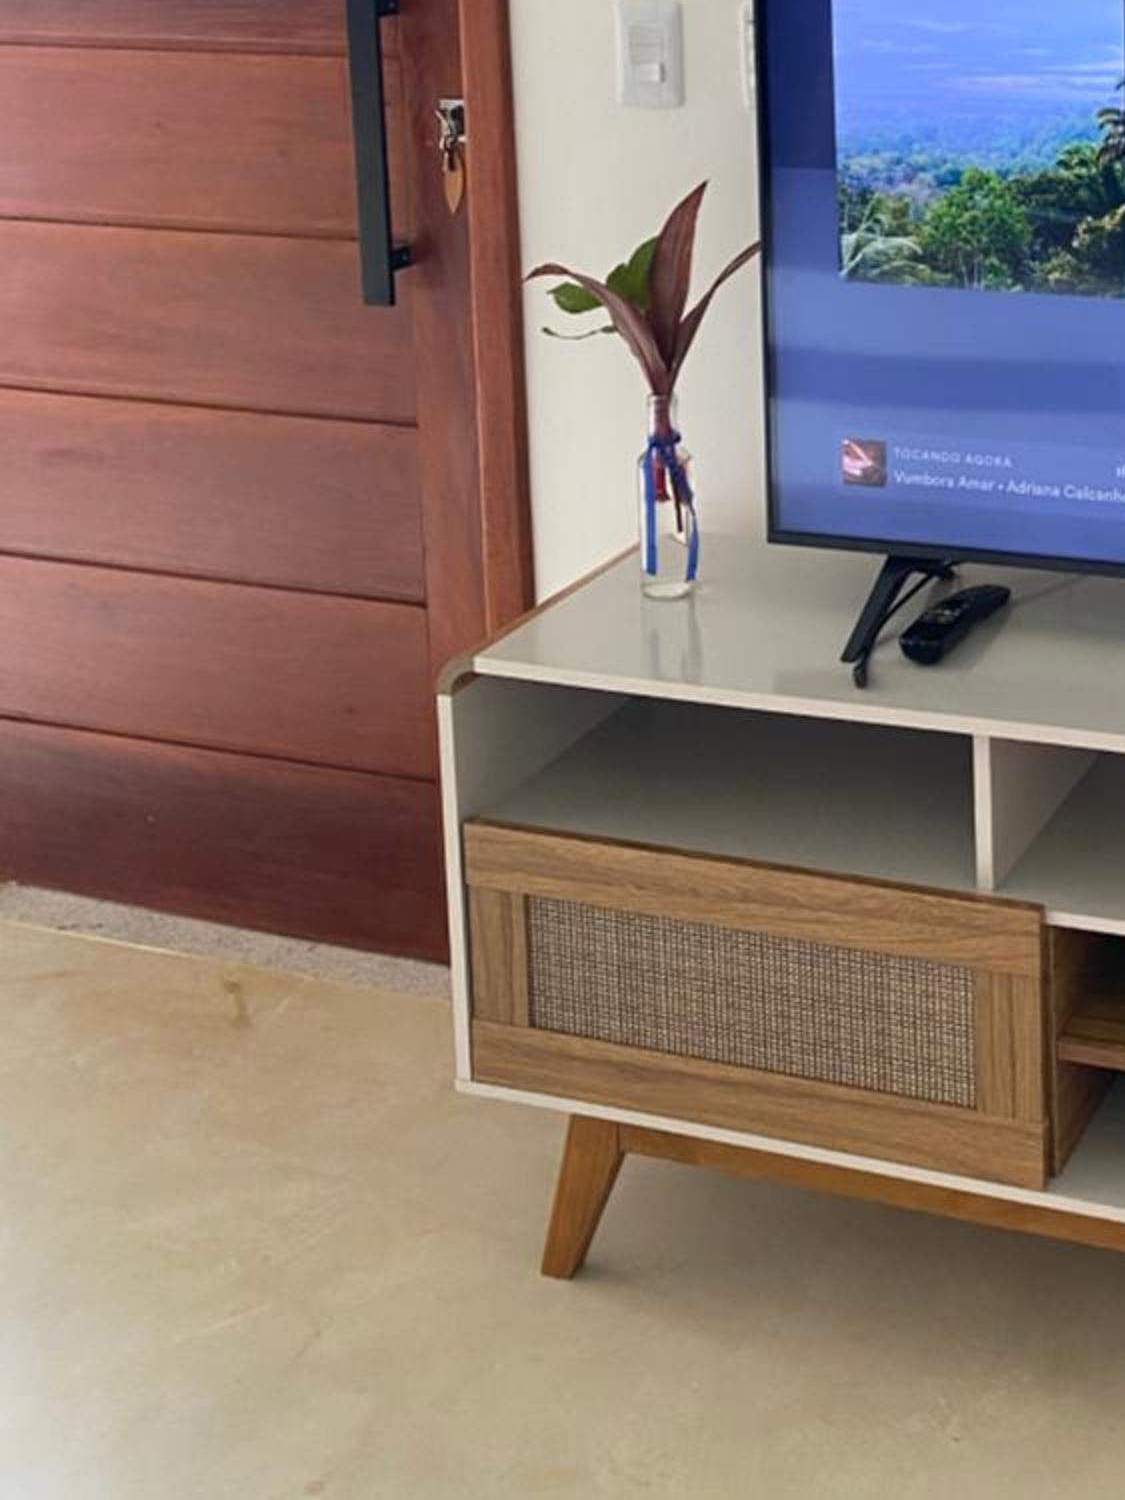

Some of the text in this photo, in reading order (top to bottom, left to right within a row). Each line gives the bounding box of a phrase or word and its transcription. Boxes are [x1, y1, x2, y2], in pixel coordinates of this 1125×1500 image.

[893, 447, 1013, 468] TOCANDO AGORA
[893, 470, 954, 489] Vumbora
[959, 476, 994, 492] Amar
[1007, 479, 1060, 498] Adriana
